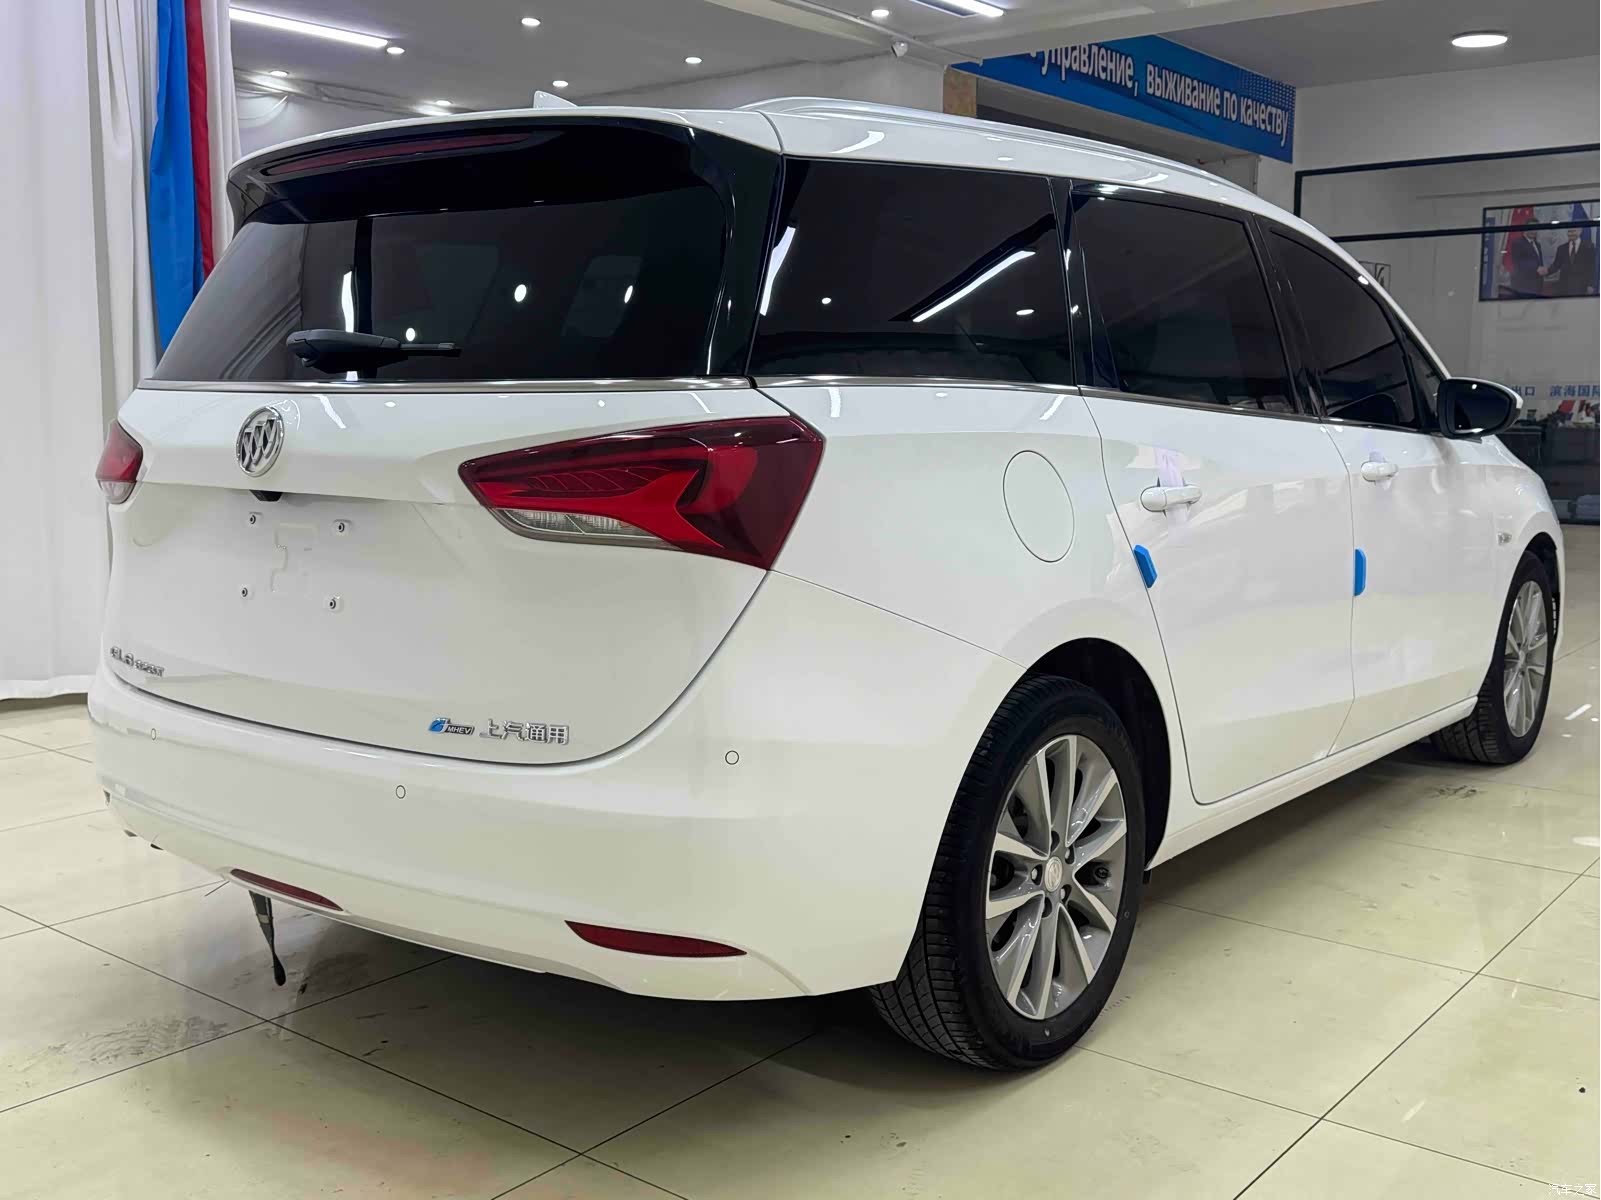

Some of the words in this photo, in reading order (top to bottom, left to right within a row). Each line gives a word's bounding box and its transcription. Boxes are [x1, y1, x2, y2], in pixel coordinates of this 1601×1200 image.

[1146, 63, 1221, 117] выживание
[1222, 91, 1238, 122] по
[1240, 96, 1289, 147] качеству
[447, 726, 471, 735] MHEV
[479, 718, 569, 745] 上汽通用
